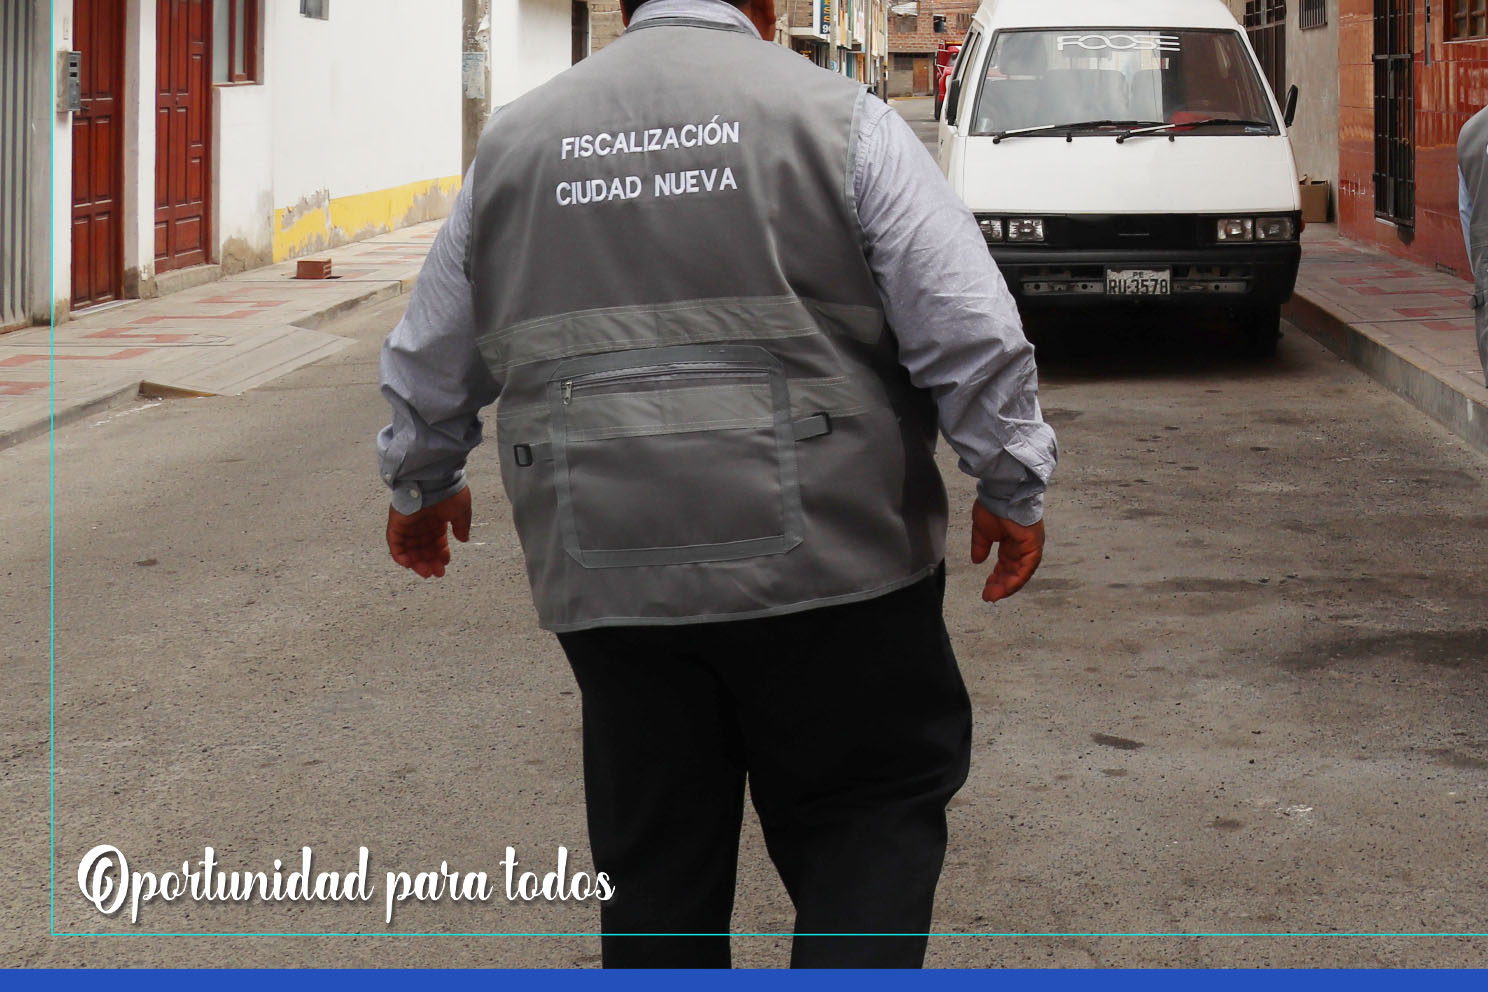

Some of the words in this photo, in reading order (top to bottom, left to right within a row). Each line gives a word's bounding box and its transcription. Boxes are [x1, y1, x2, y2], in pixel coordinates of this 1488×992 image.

[1057, 34, 1181, 51] FOOSE
[561, 114, 740, 159] FISCALIZACIÓN
[556, 175, 642, 206] CIUDAD
[654, 167, 737, 197] NUEVA
